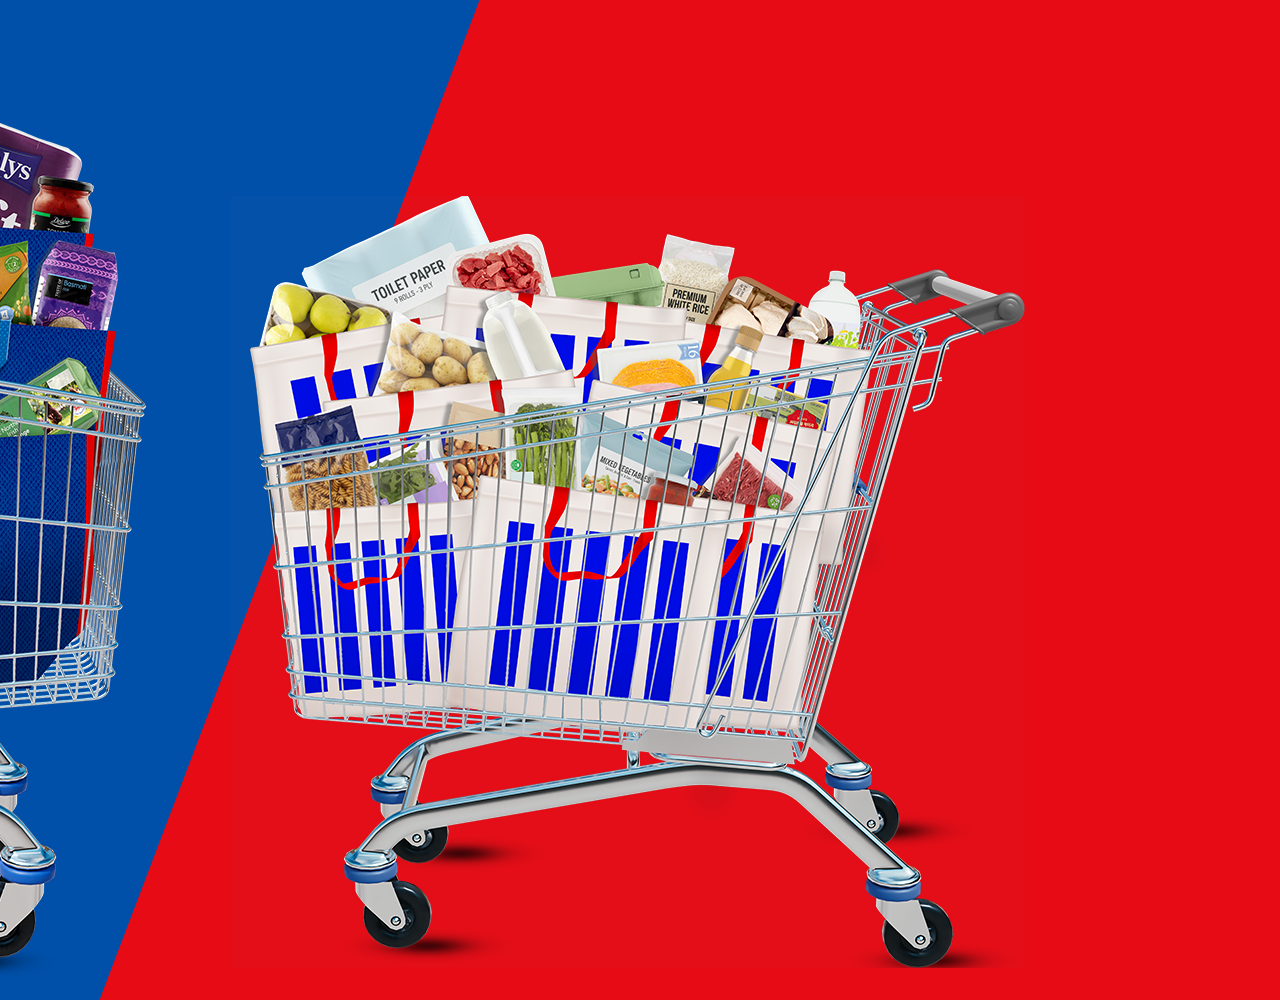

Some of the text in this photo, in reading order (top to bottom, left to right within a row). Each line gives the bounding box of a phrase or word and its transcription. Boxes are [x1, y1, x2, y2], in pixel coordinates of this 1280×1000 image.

[371, 259, 446, 302] TOILET PAPER
[398, 290, 416, 302] ROLLS
[423, 281, 434, 291] PLY
[672, 288, 707, 304] PREMIUM
[667, 298, 710, 315] WHITE RICE
[600, 456, 618, 469] MIXED
[620, 464, 652, 484] EGETABES
